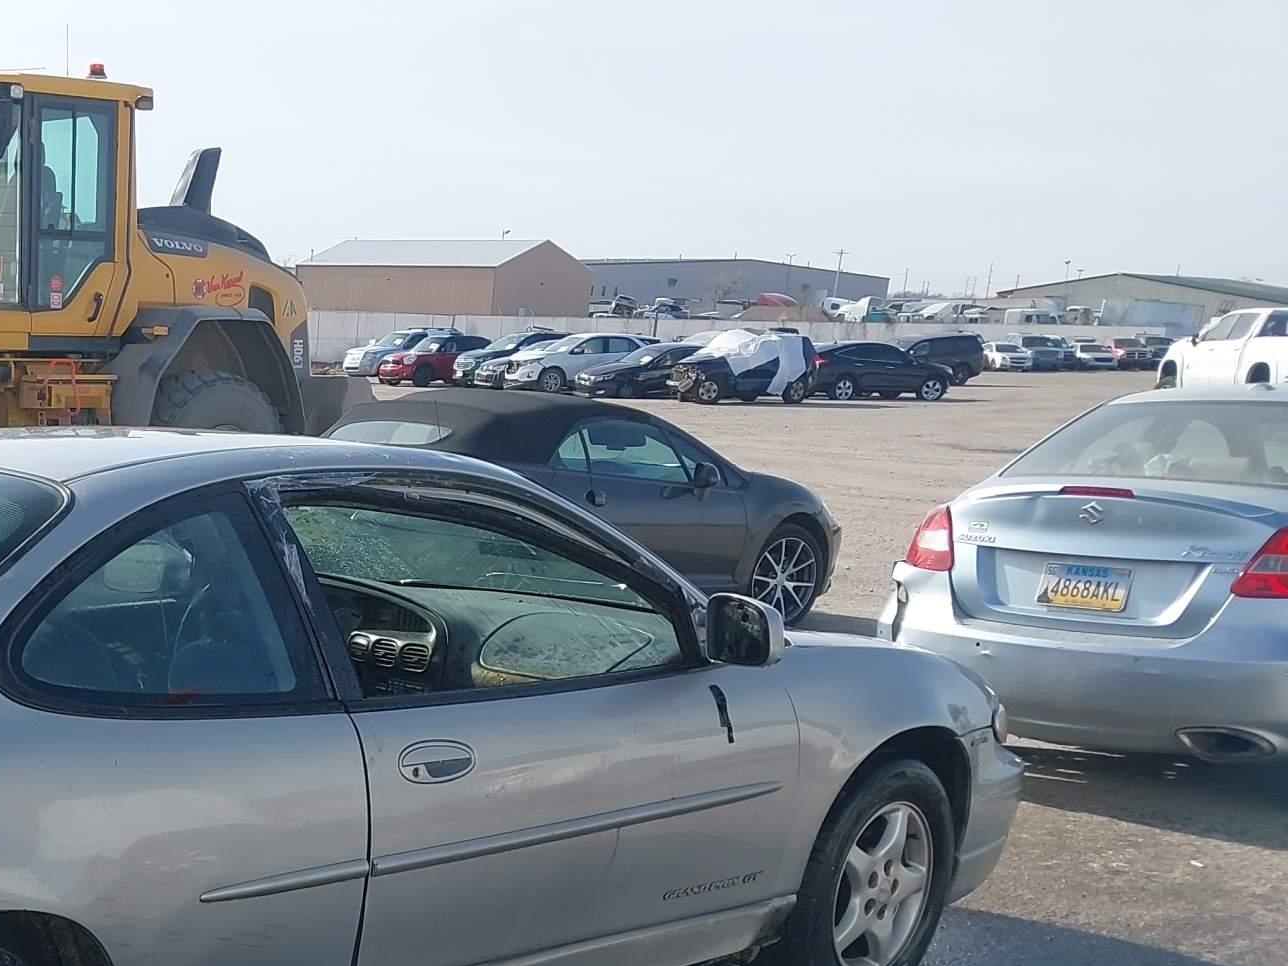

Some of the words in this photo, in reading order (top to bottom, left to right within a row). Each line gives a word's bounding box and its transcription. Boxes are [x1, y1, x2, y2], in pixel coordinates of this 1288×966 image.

[152, 238, 203, 252] VOLVO
[293, 339, 304, 369] L90H
[958, 533, 997, 544] SUZUKI
[1066, 565, 1110, 578] KANSAS
[1050, 578, 1120, 602] 4868AKL
[742, 870, 764, 884] GT
